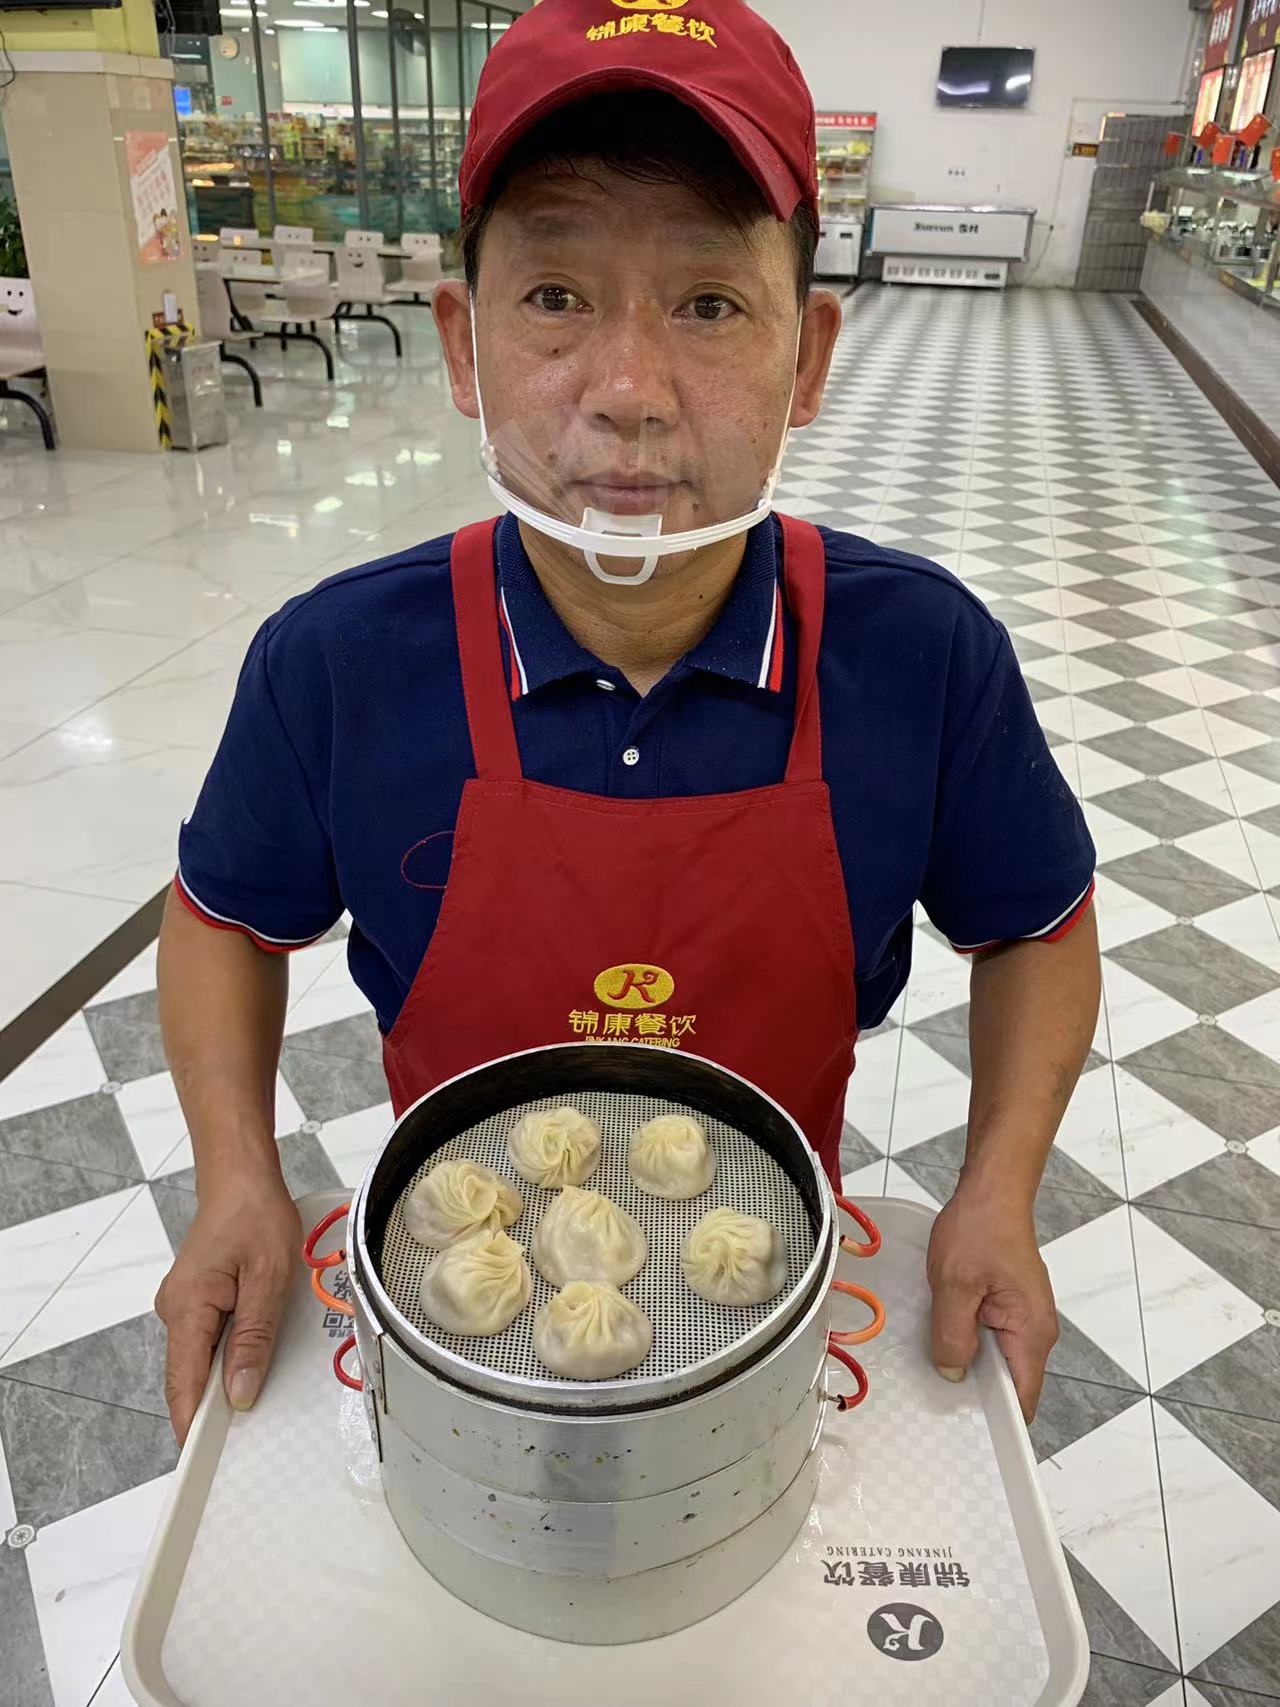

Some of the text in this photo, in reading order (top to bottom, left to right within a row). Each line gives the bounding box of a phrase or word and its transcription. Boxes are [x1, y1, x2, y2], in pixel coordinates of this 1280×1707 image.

[568, 1009, 697, 1037] 锦康餐饮
[826, 1546, 952, 1558] JINKANG CATERING
[821, 1560, 970, 1588] 锦康餐饮
